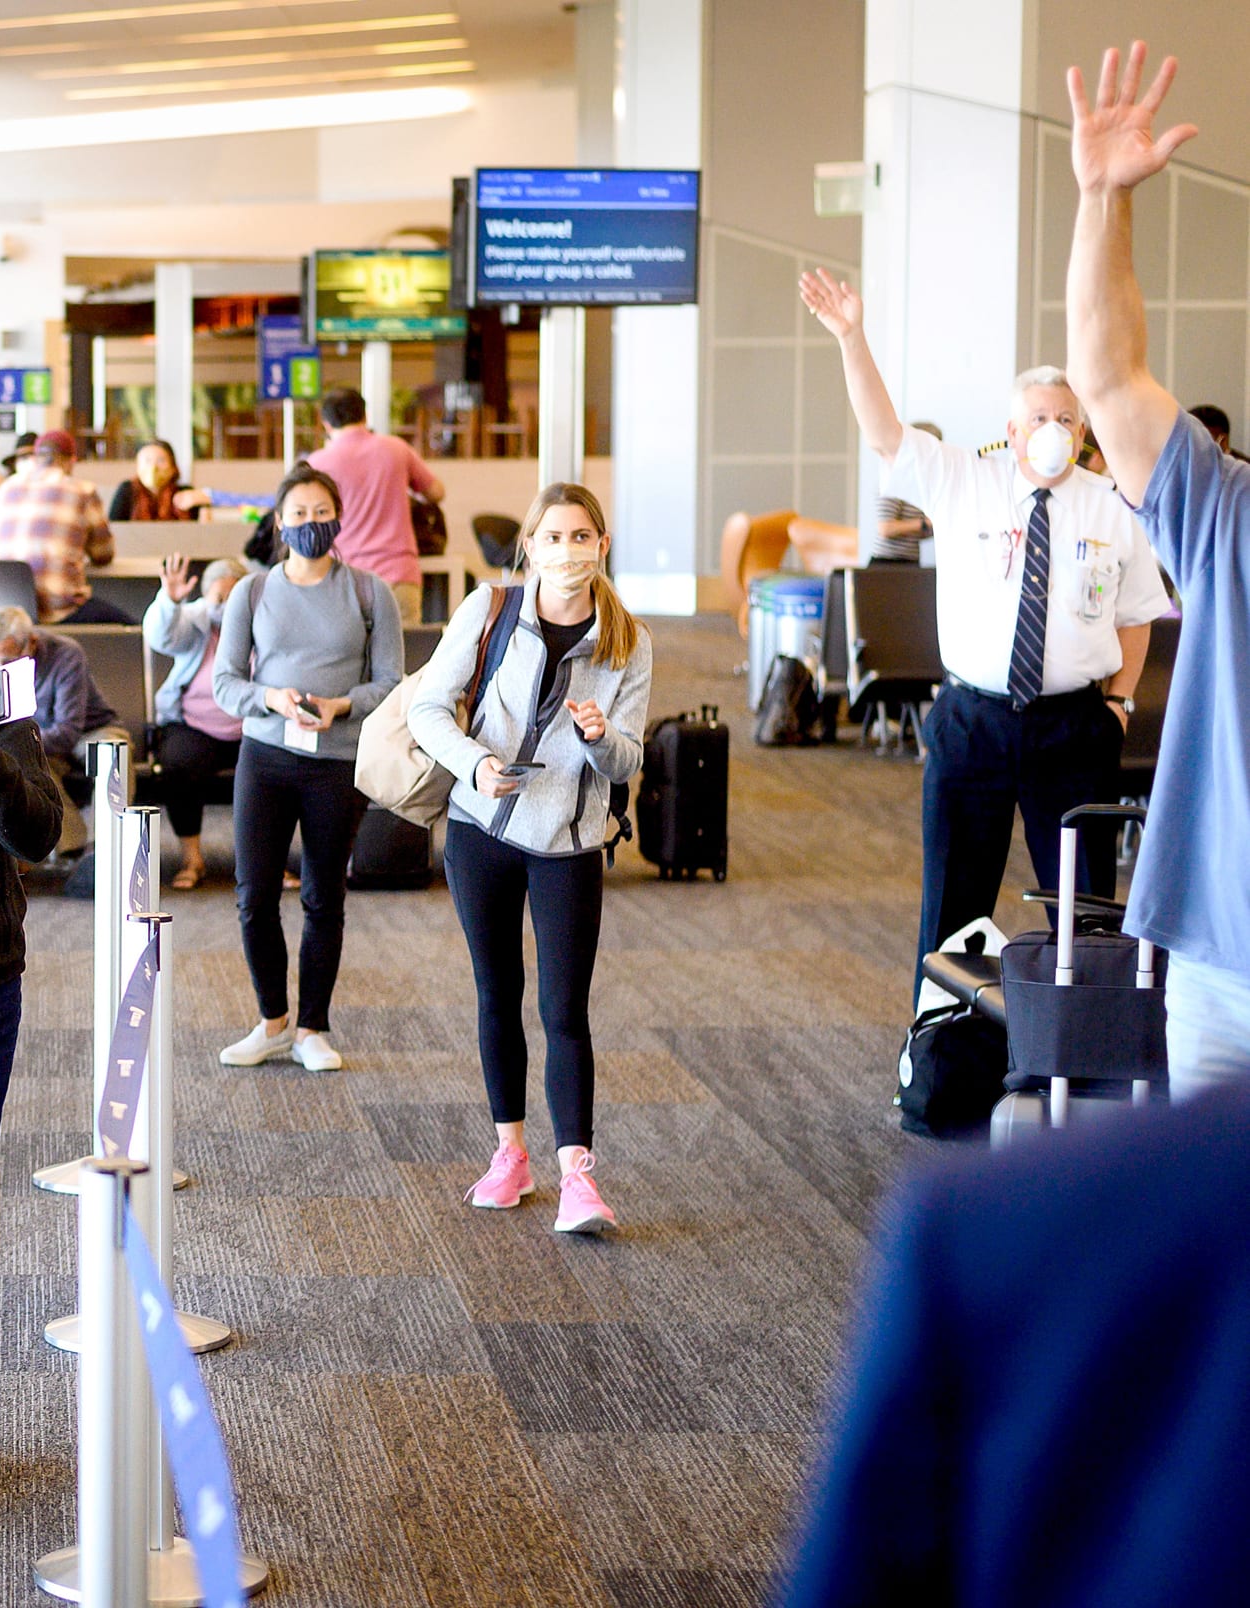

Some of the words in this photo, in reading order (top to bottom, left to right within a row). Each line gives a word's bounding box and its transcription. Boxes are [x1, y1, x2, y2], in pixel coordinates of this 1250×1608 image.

[485, 218, 572, 239] Welcome!
[485, 244, 525, 260] Please
[527, 244, 561, 260] make
[562, 245, 612, 263] yourself
[613, 247, 686, 262] comfortable
[485, 263, 515, 279] until
[516, 266, 544, 281] your
[545, 266, 582, 281] group
[583, 265, 594, 279] is
[595, 264, 635, 279] called.
